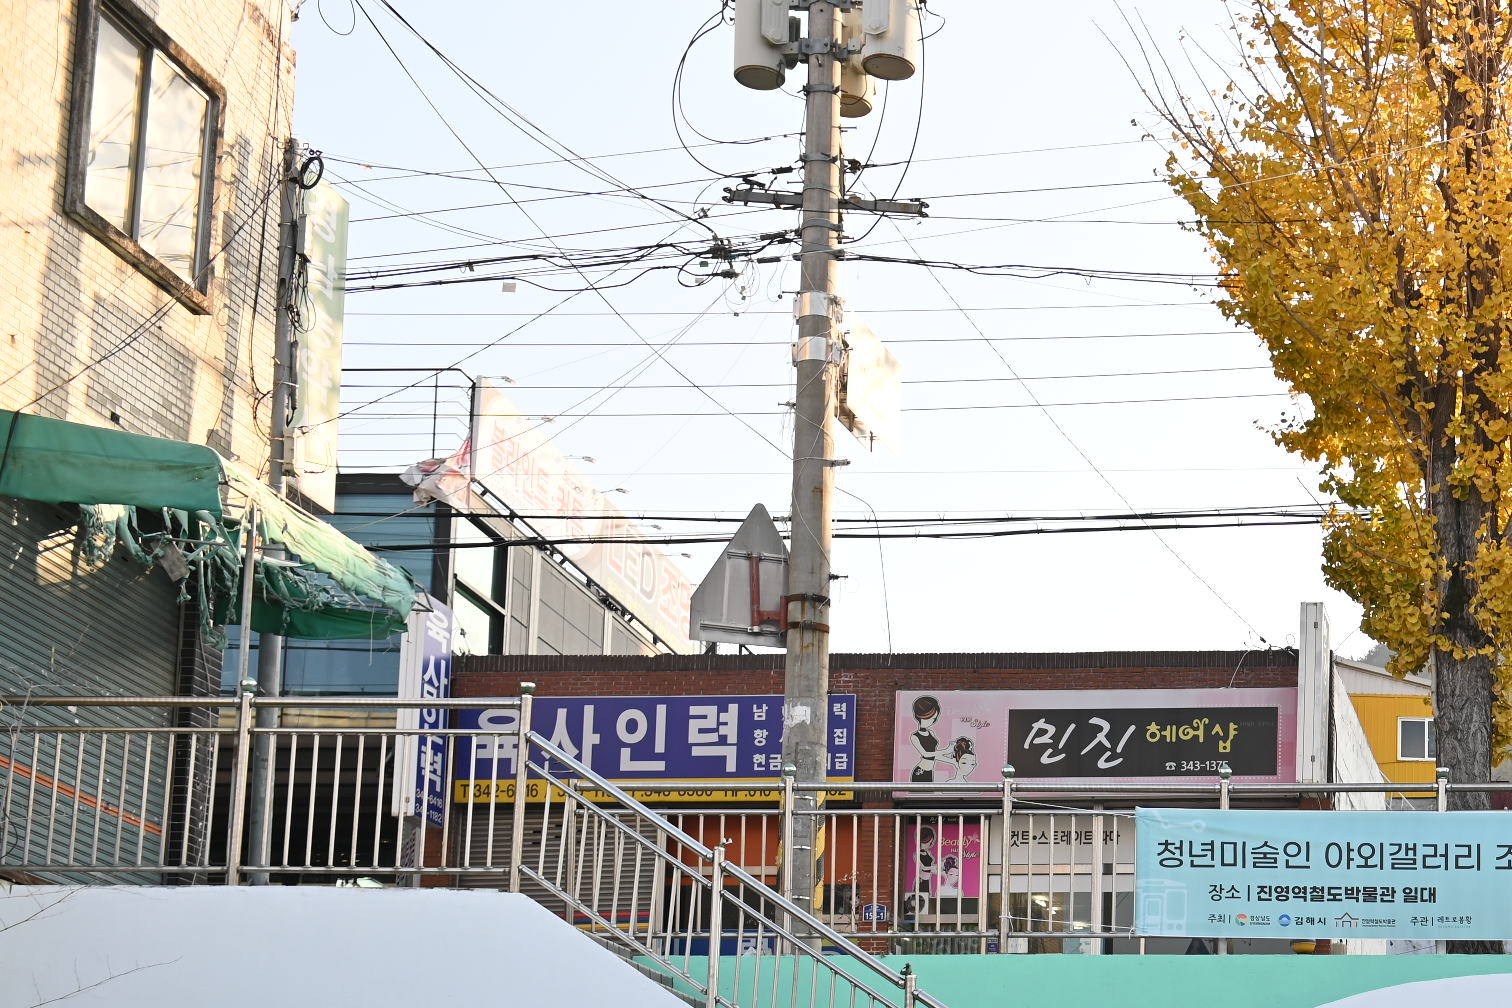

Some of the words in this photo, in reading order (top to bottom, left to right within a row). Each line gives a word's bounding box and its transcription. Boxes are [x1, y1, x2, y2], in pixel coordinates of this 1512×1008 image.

[1157, 840, 1311, 870] 청년미술인
[1325, 841, 1481, 871] 야외갤러리
[1208, 884, 1241, 902] 장소
[1256, 884, 1396, 903] 진영역철도박물관
[1402, 886, 1437, 904] 일대
[1208, 913, 1226, 924] 주최
[1294, 916, 1327, 926] 김해시
[1410, 916, 1428, 927] 주관
